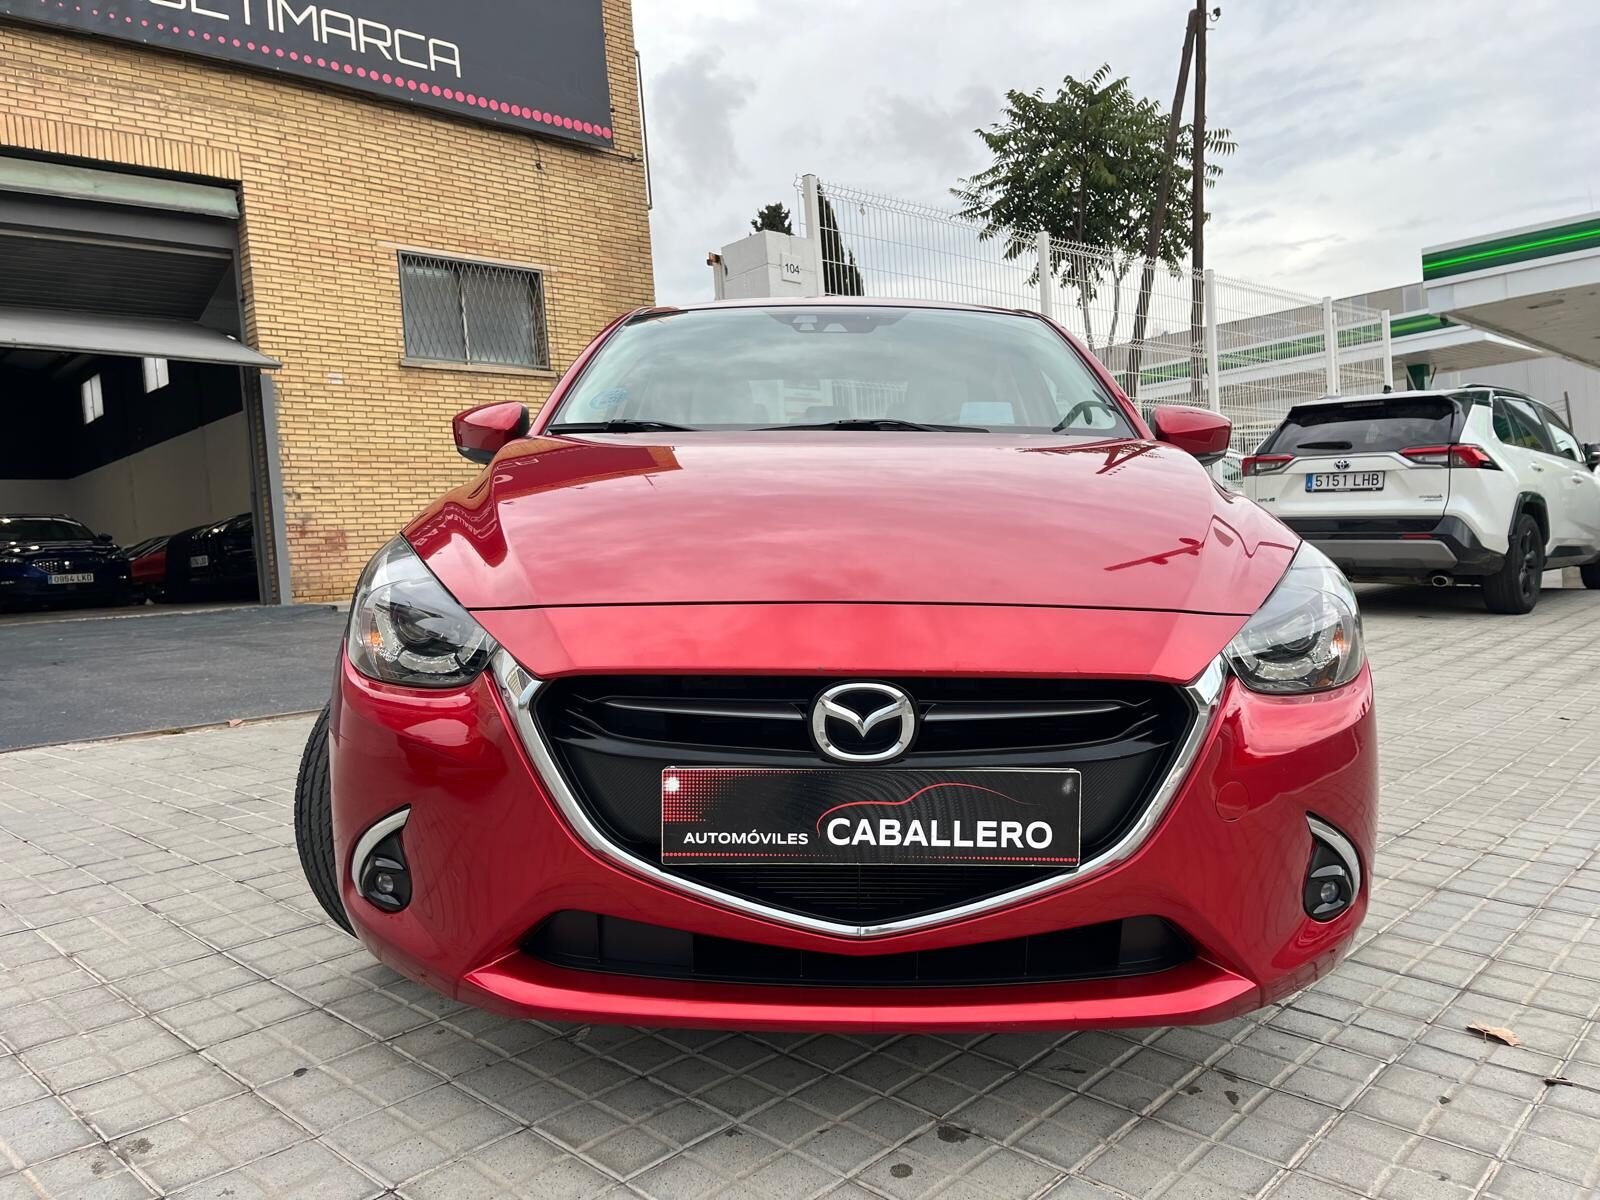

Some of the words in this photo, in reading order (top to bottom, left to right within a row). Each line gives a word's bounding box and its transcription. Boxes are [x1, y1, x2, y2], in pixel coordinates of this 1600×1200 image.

[785, 263, 800, 274] 104
[1315, 474, 1346, 487] 5151
[1353, 473, 1380, 487] LHB
[683, 829, 809, 845] AUTOMÓVILES
[826, 817, 1053, 849] CABALLERO
